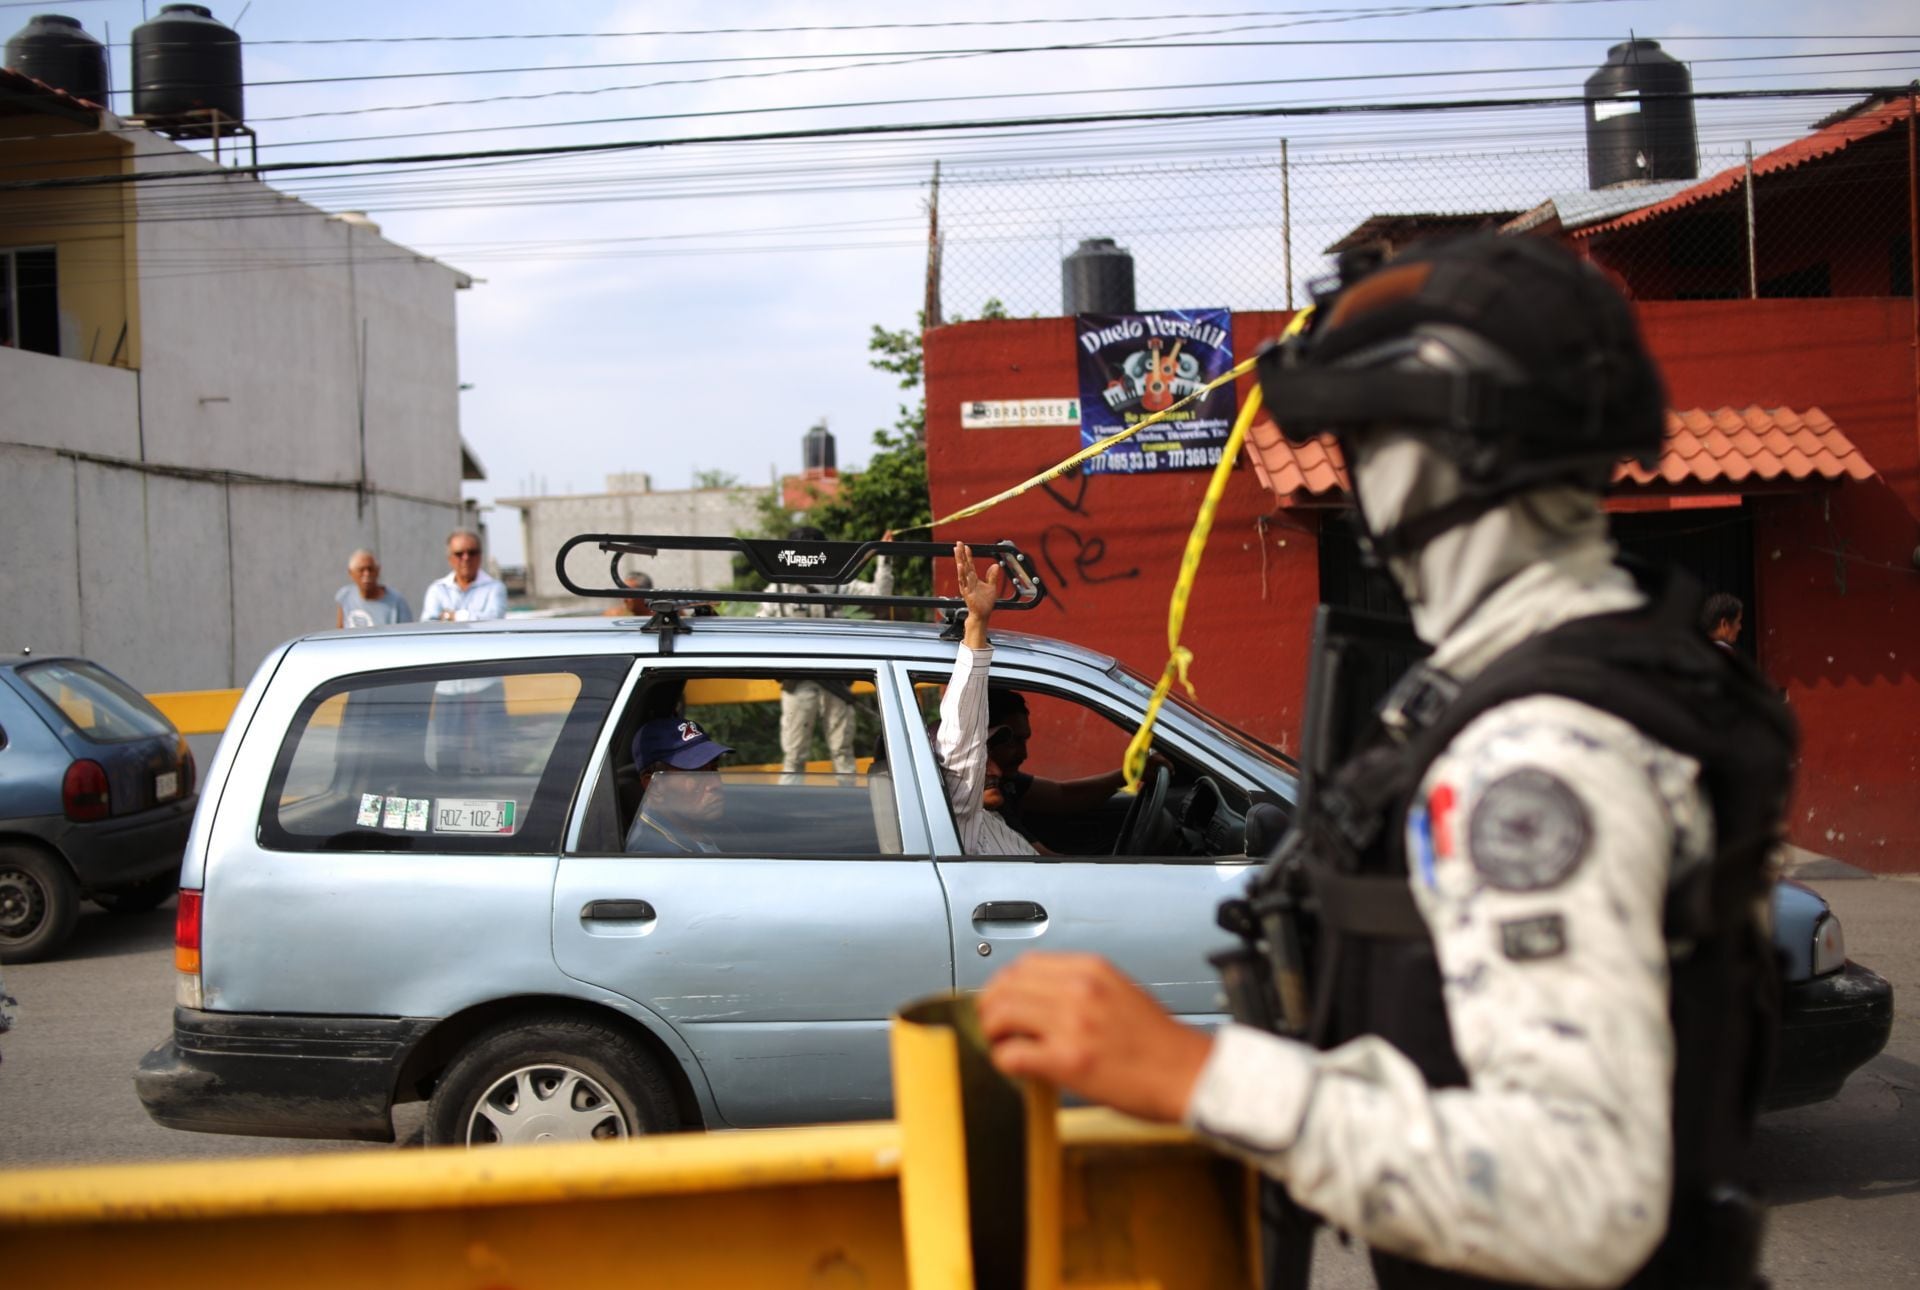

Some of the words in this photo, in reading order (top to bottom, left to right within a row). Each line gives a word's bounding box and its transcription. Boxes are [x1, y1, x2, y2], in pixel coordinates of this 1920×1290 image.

[1080, 318, 1143, 354] Duelo
[985, 406, 1063, 418] OBRADORES
[1168, 449, 1185, 468] 777
